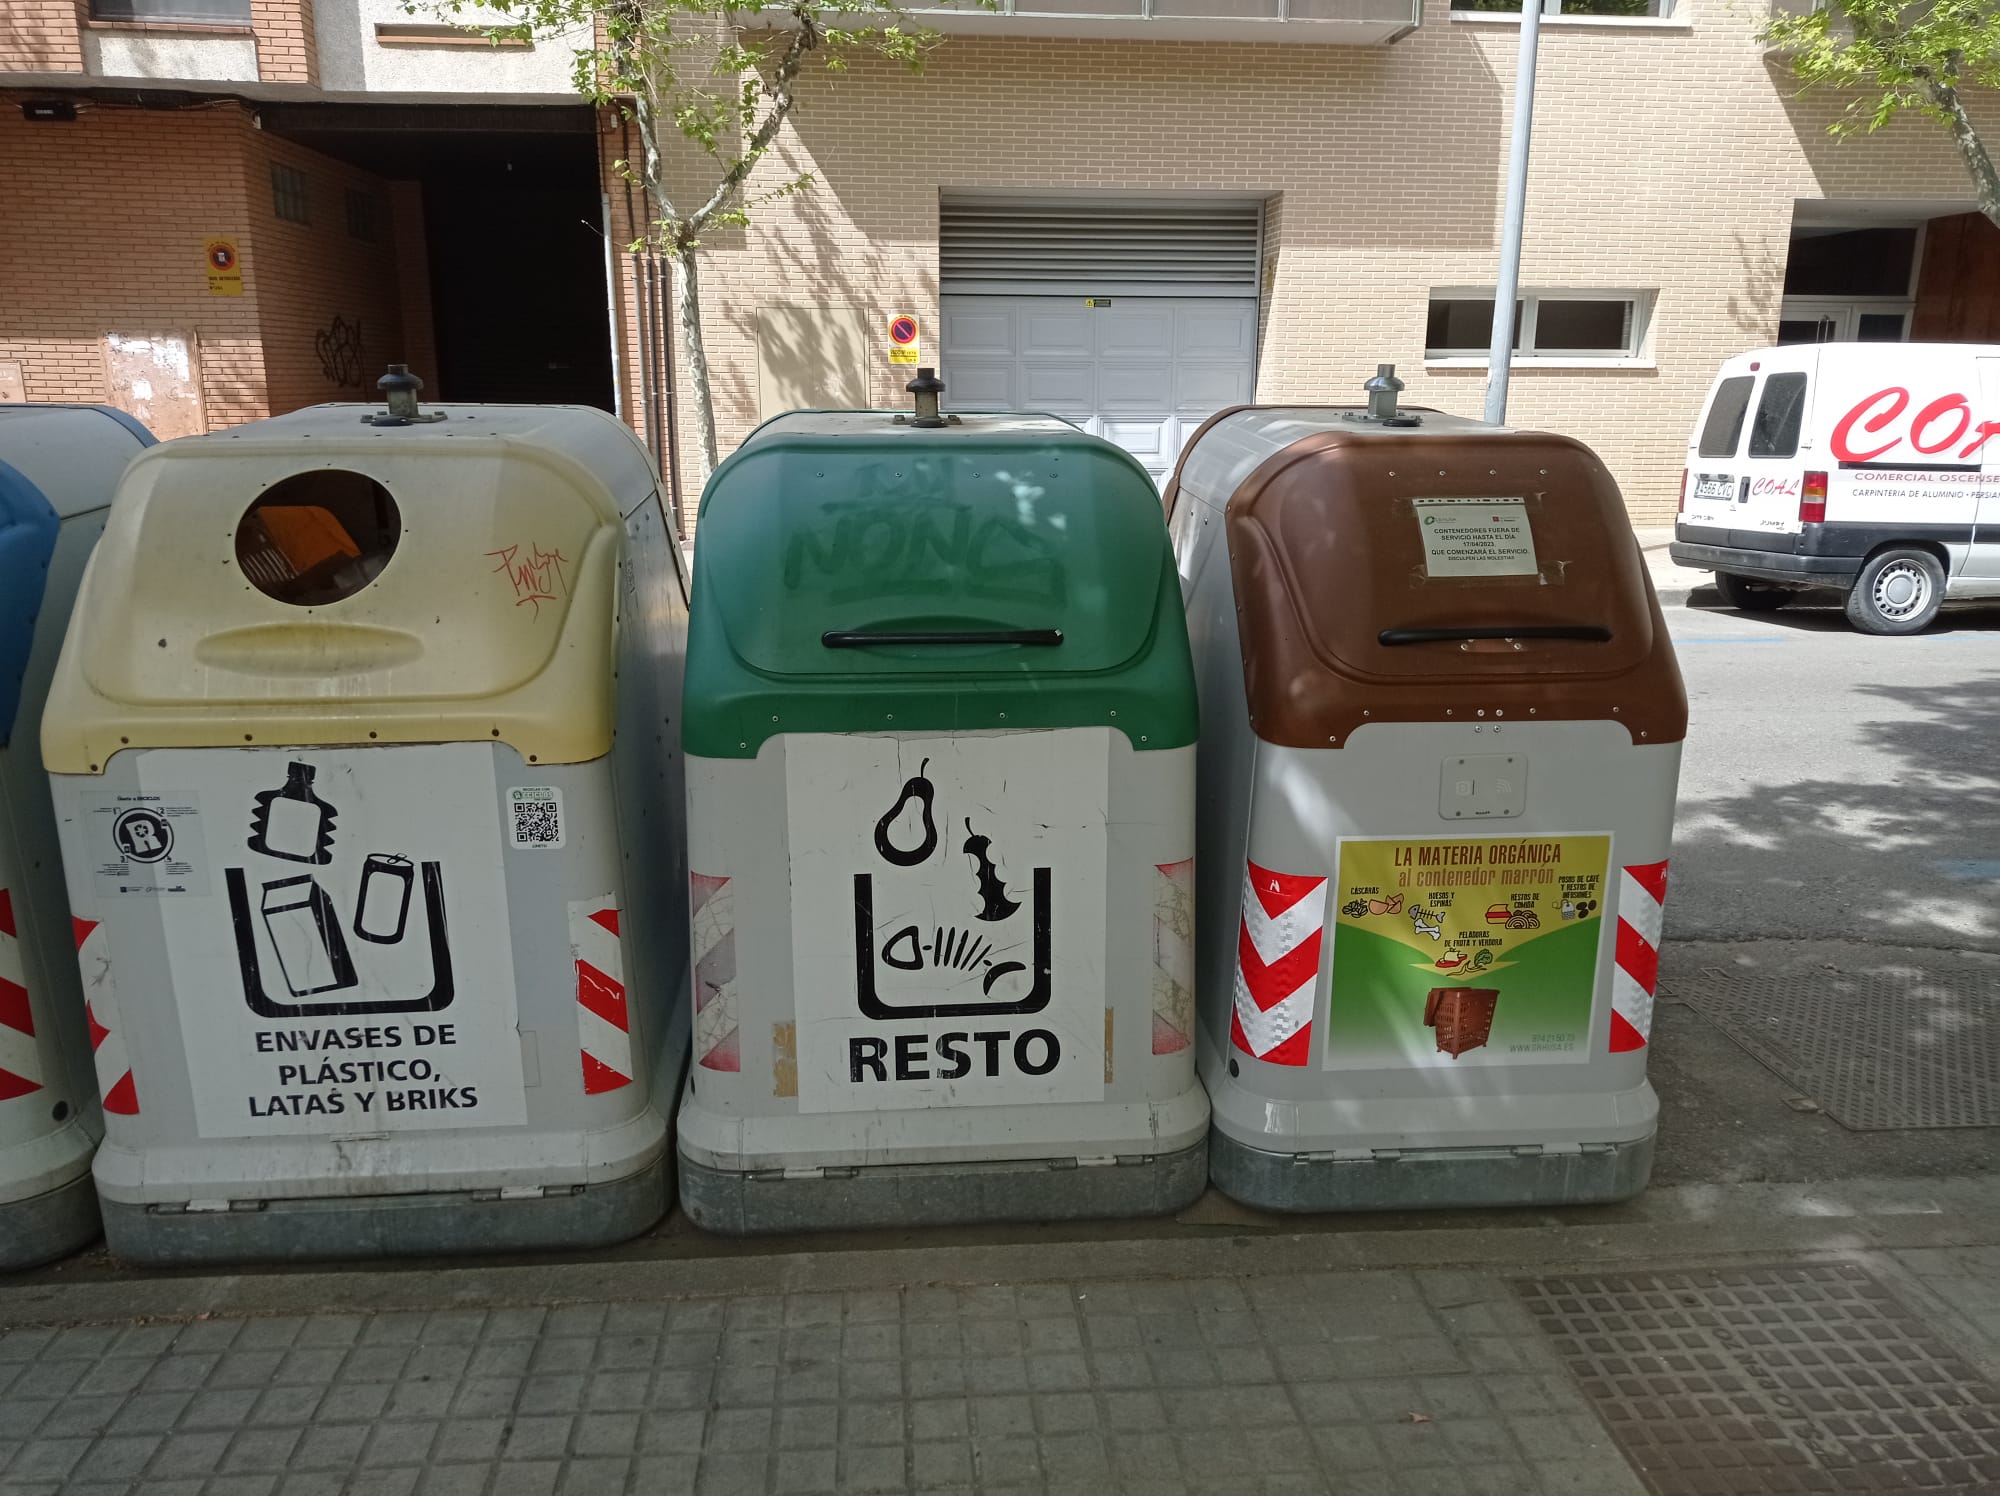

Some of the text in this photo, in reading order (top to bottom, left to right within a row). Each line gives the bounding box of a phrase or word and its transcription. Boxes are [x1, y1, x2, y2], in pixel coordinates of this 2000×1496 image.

[1752, 477, 1800, 496] COAL
[1854, 472, 2000, 483] COMERCIAL OSCENSE
[1908, 490, 1920, 498] DE
[1922, 490, 1964, 499] ALUMINIO
[1395, 840, 1561, 866] LA MATERIA ORGÁNICA
[1399, 864, 1554, 887] al contenedor marrón
[1428, 892, 1449, 900] HUESOS
[1510, 893, 1540, 901] RESTOS DE
[1513, 901, 1535, 909] COMIDA
[1444, 939, 1451, 947] DE
[1453, 939, 1470, 947] FRUTA
[1479, 938, 1502, 946] VERDURA
[255, 1024, 457, 1052] ENVASES DE
[849, 1028, 1061, 1083] RESTO
[278, 1056, 441, 1086] PLÁSTICO,
[248, 1086, 478, 1117] LATAS Y BRIKS
